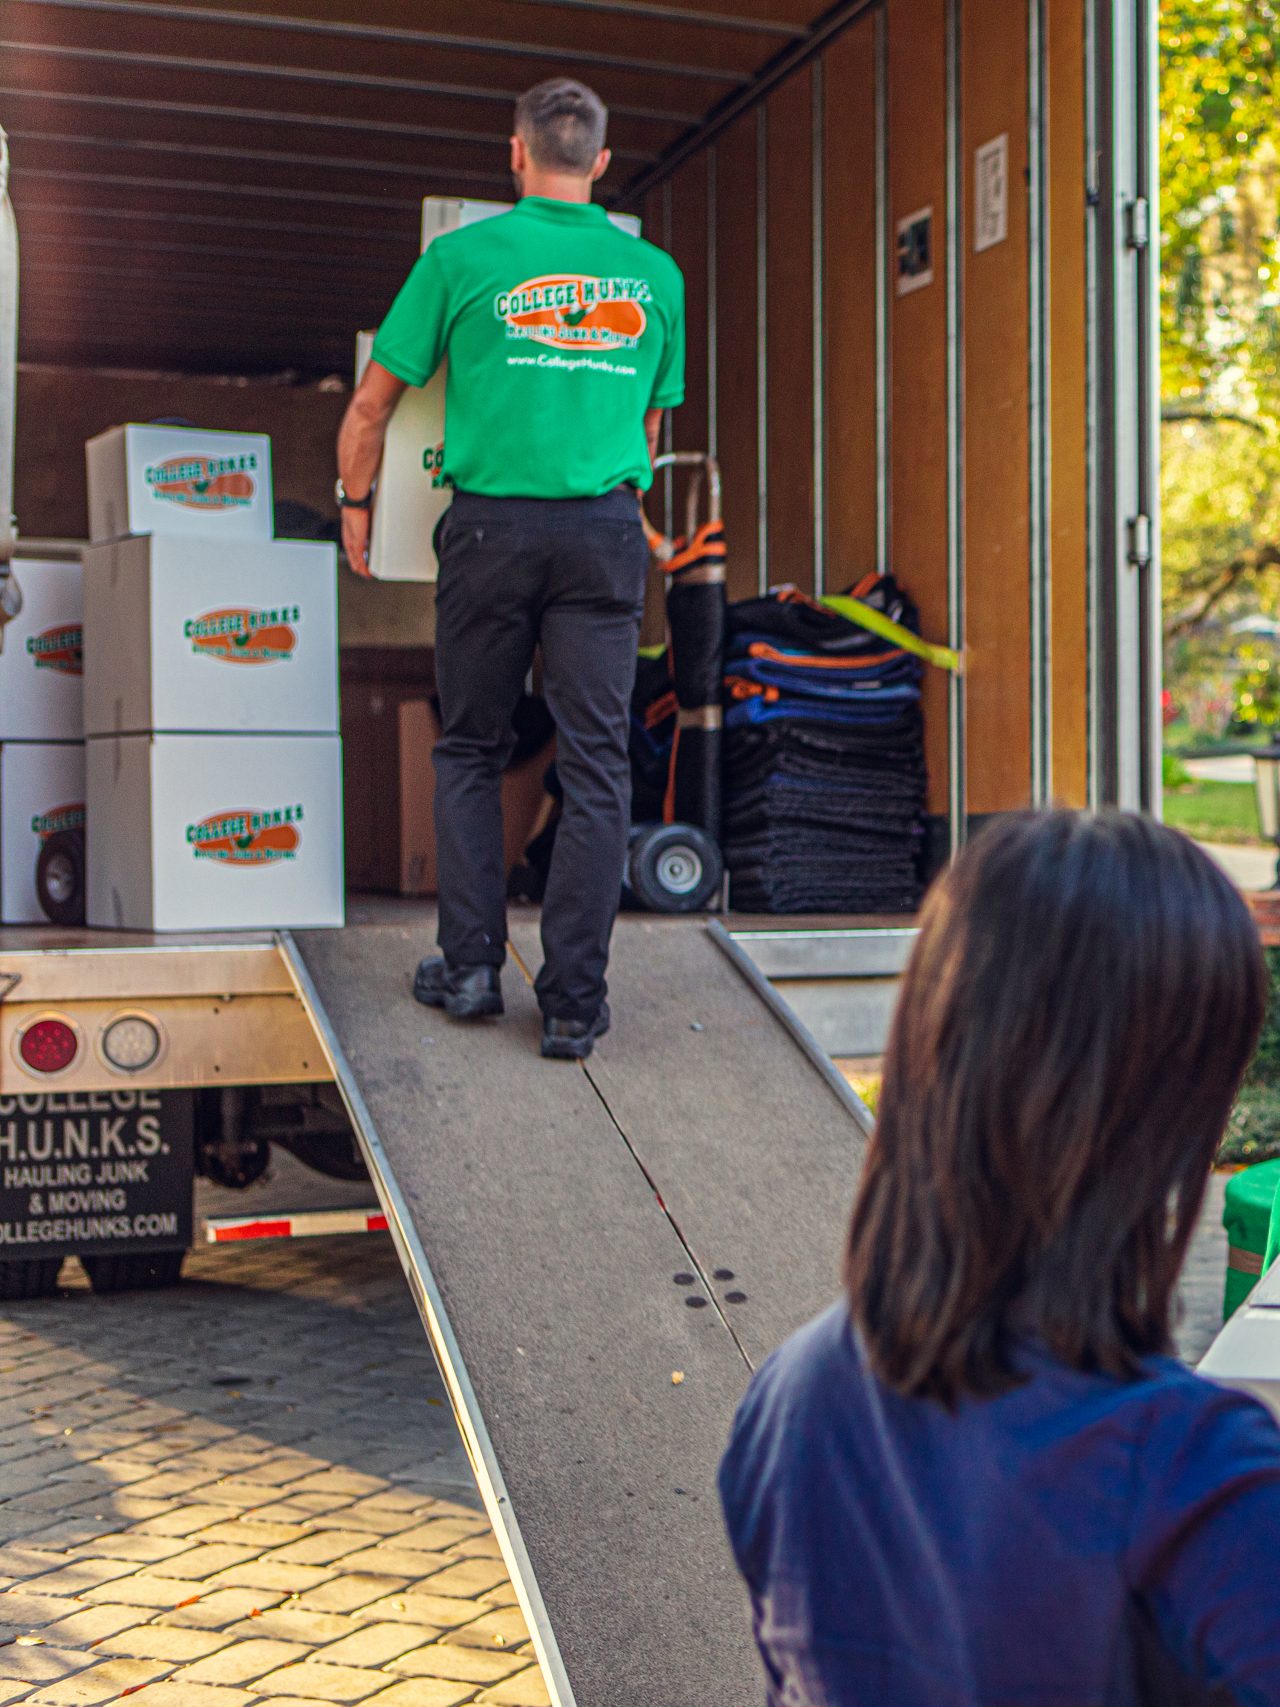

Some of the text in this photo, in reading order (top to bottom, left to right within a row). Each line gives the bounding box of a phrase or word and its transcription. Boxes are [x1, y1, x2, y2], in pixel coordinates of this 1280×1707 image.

[496, 283, 579, 318] COLLEGE
[4, 1159, 149, 1190] HAULING JUNK
[28, 1188, 127, 1215] & MOVING
